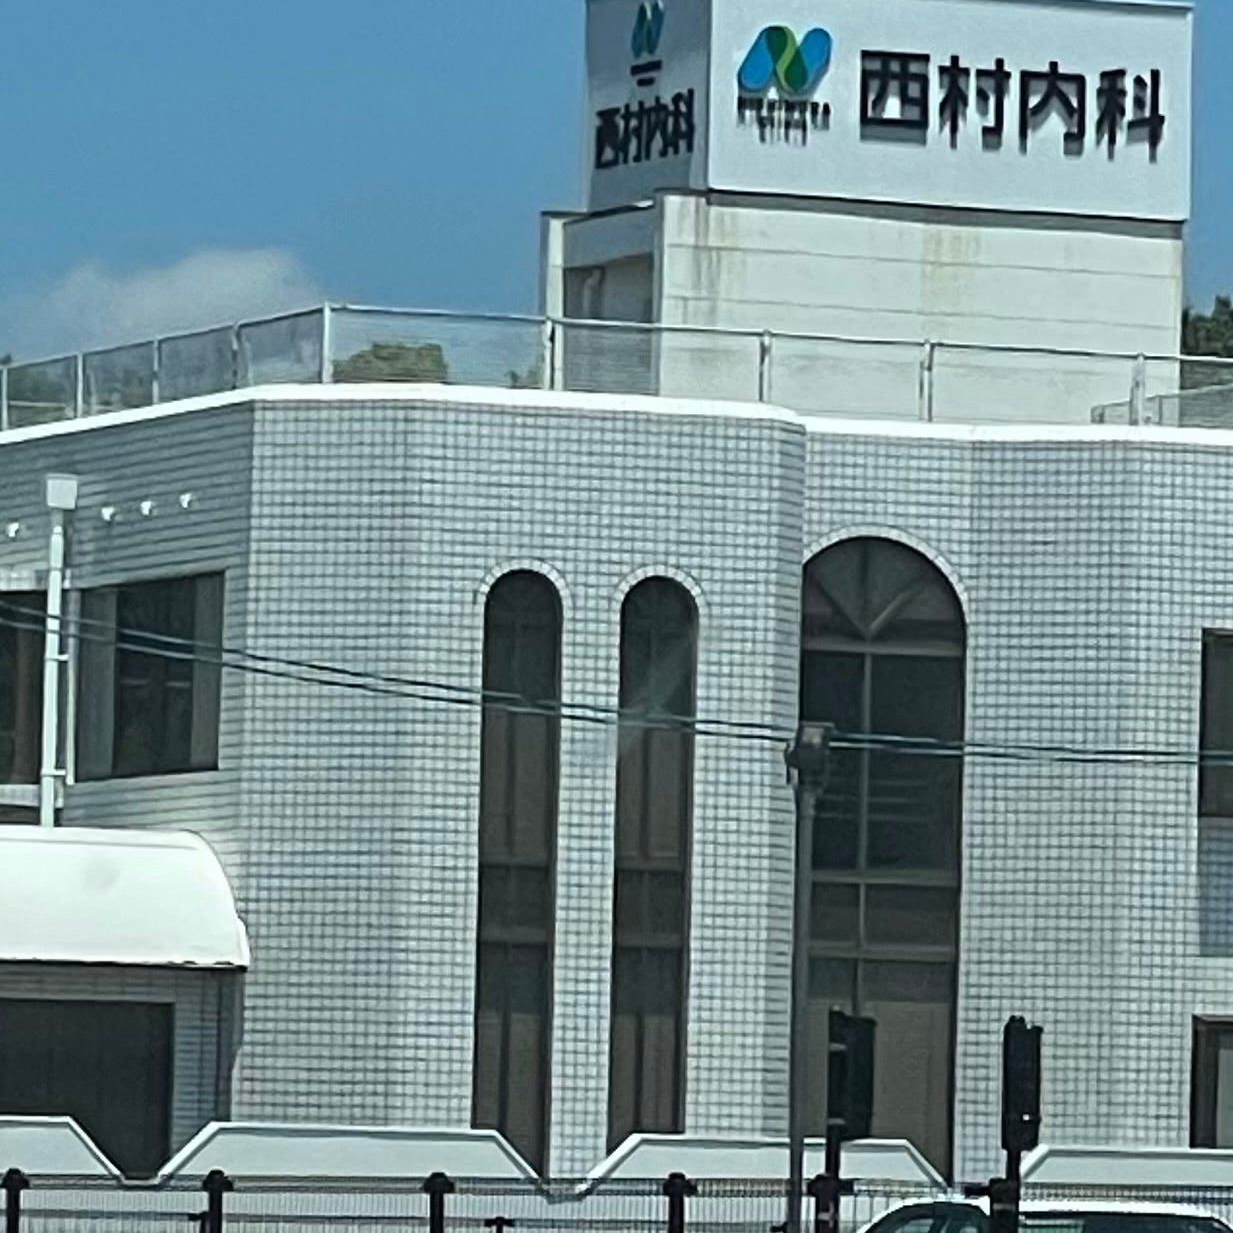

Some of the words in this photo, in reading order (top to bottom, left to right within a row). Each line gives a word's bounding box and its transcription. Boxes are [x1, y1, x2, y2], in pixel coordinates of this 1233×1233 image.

[595, 88, 695, 169] 西村内科
[859, 49, 1166, 160] 西村内科
